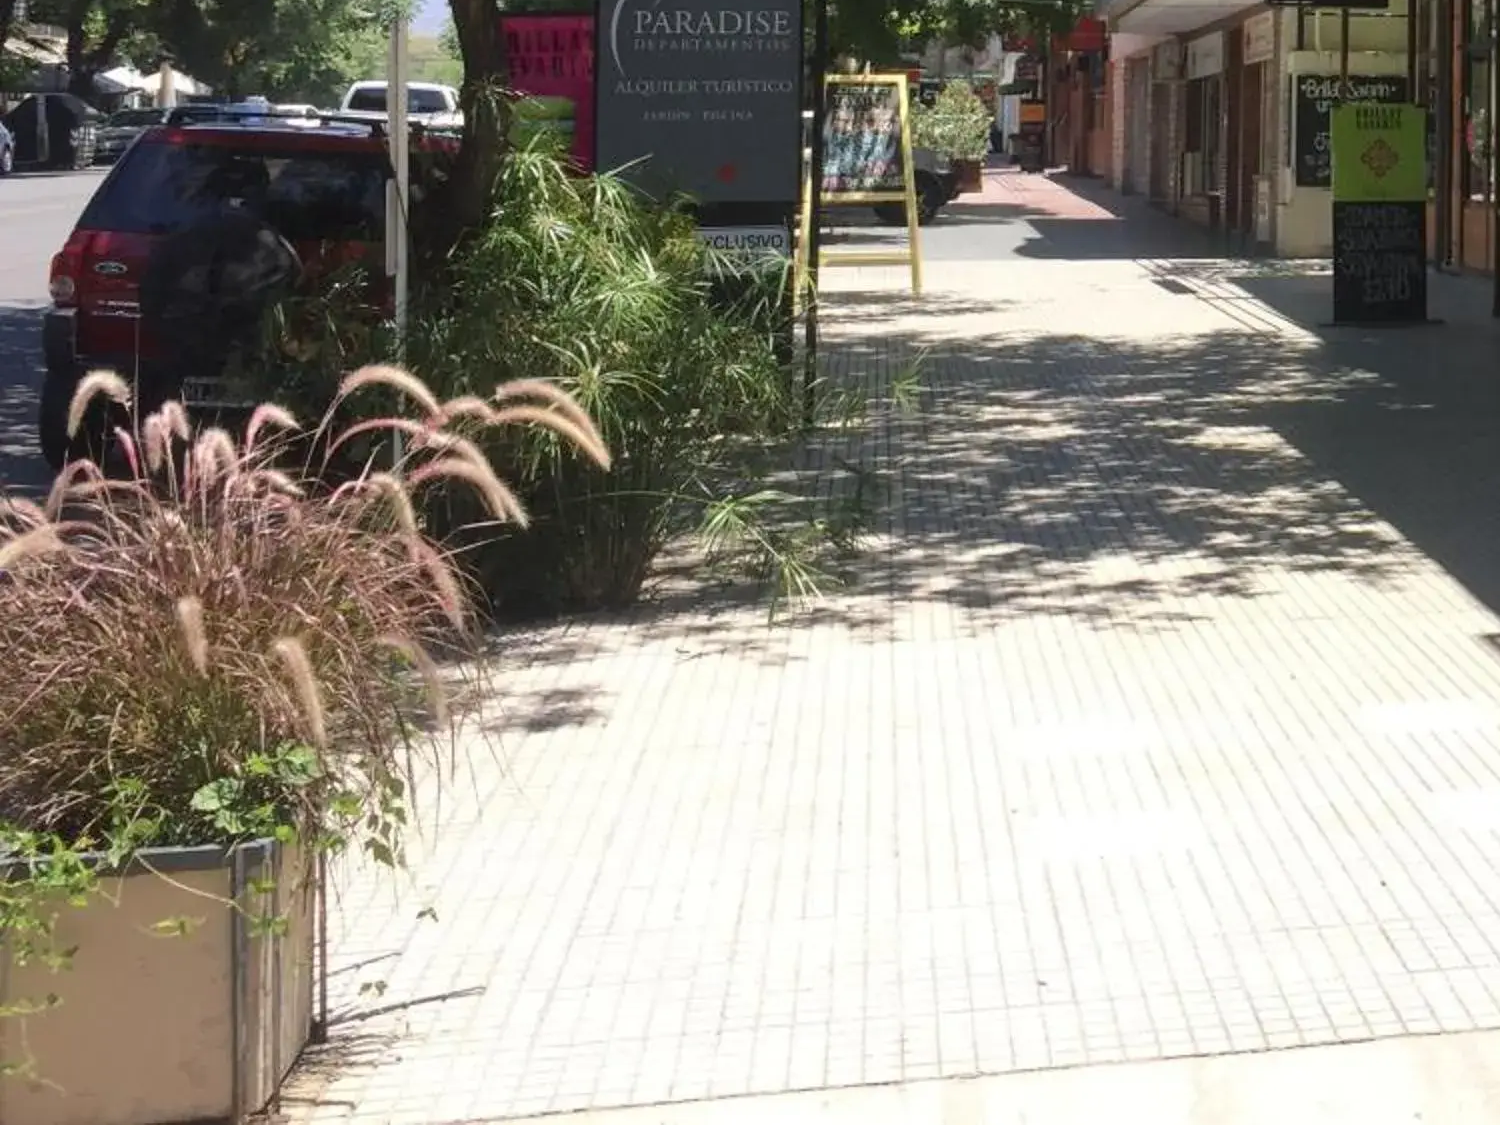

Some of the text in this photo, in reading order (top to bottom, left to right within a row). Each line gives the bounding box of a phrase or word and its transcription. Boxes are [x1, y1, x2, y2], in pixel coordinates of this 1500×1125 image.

[633, 9, 792, 36] PARADISE
[633, 38, 792, 52] DEPARTAMENTOS
[614, 79, 698, 97] ALQUILER
